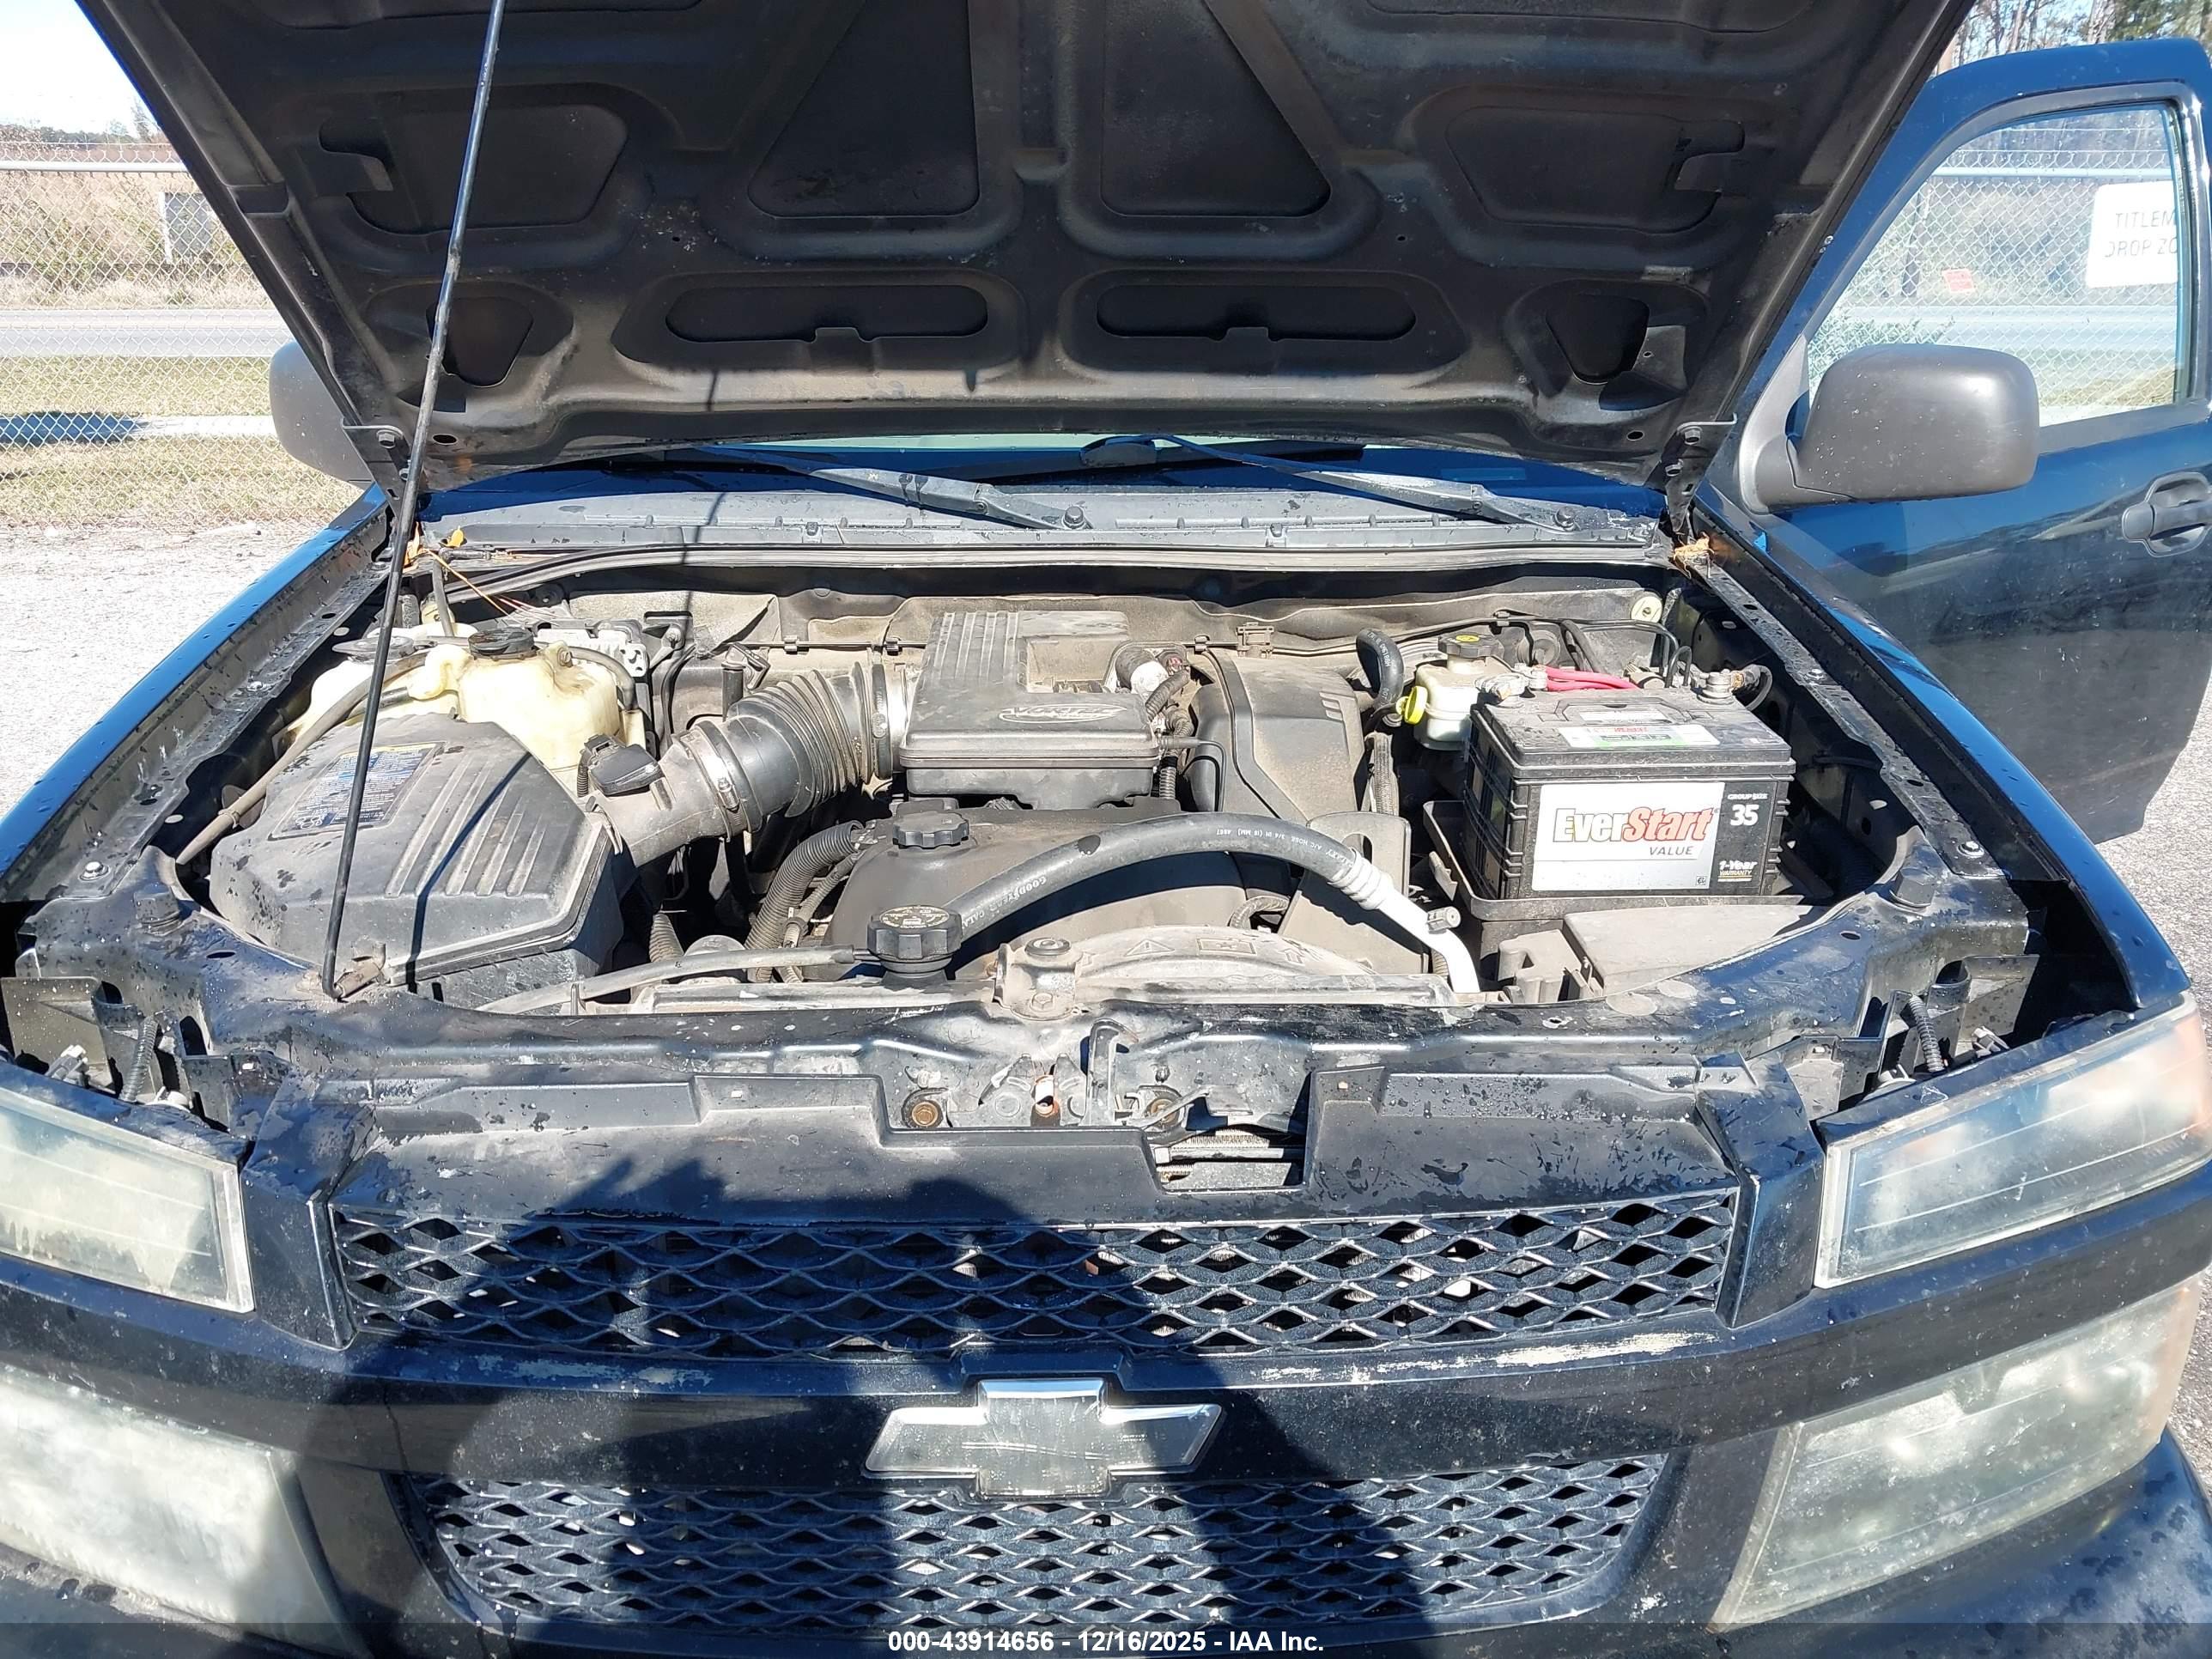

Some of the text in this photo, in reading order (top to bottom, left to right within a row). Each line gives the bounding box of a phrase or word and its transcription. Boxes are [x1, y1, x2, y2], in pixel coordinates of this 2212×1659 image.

[1730, 804, 1759, 826] 35
[1552, 806, 1713, 842] EverStart
[1649, 846, 1693, 855] VALUE
[1719, 860, 1757, 870] 1-Year
